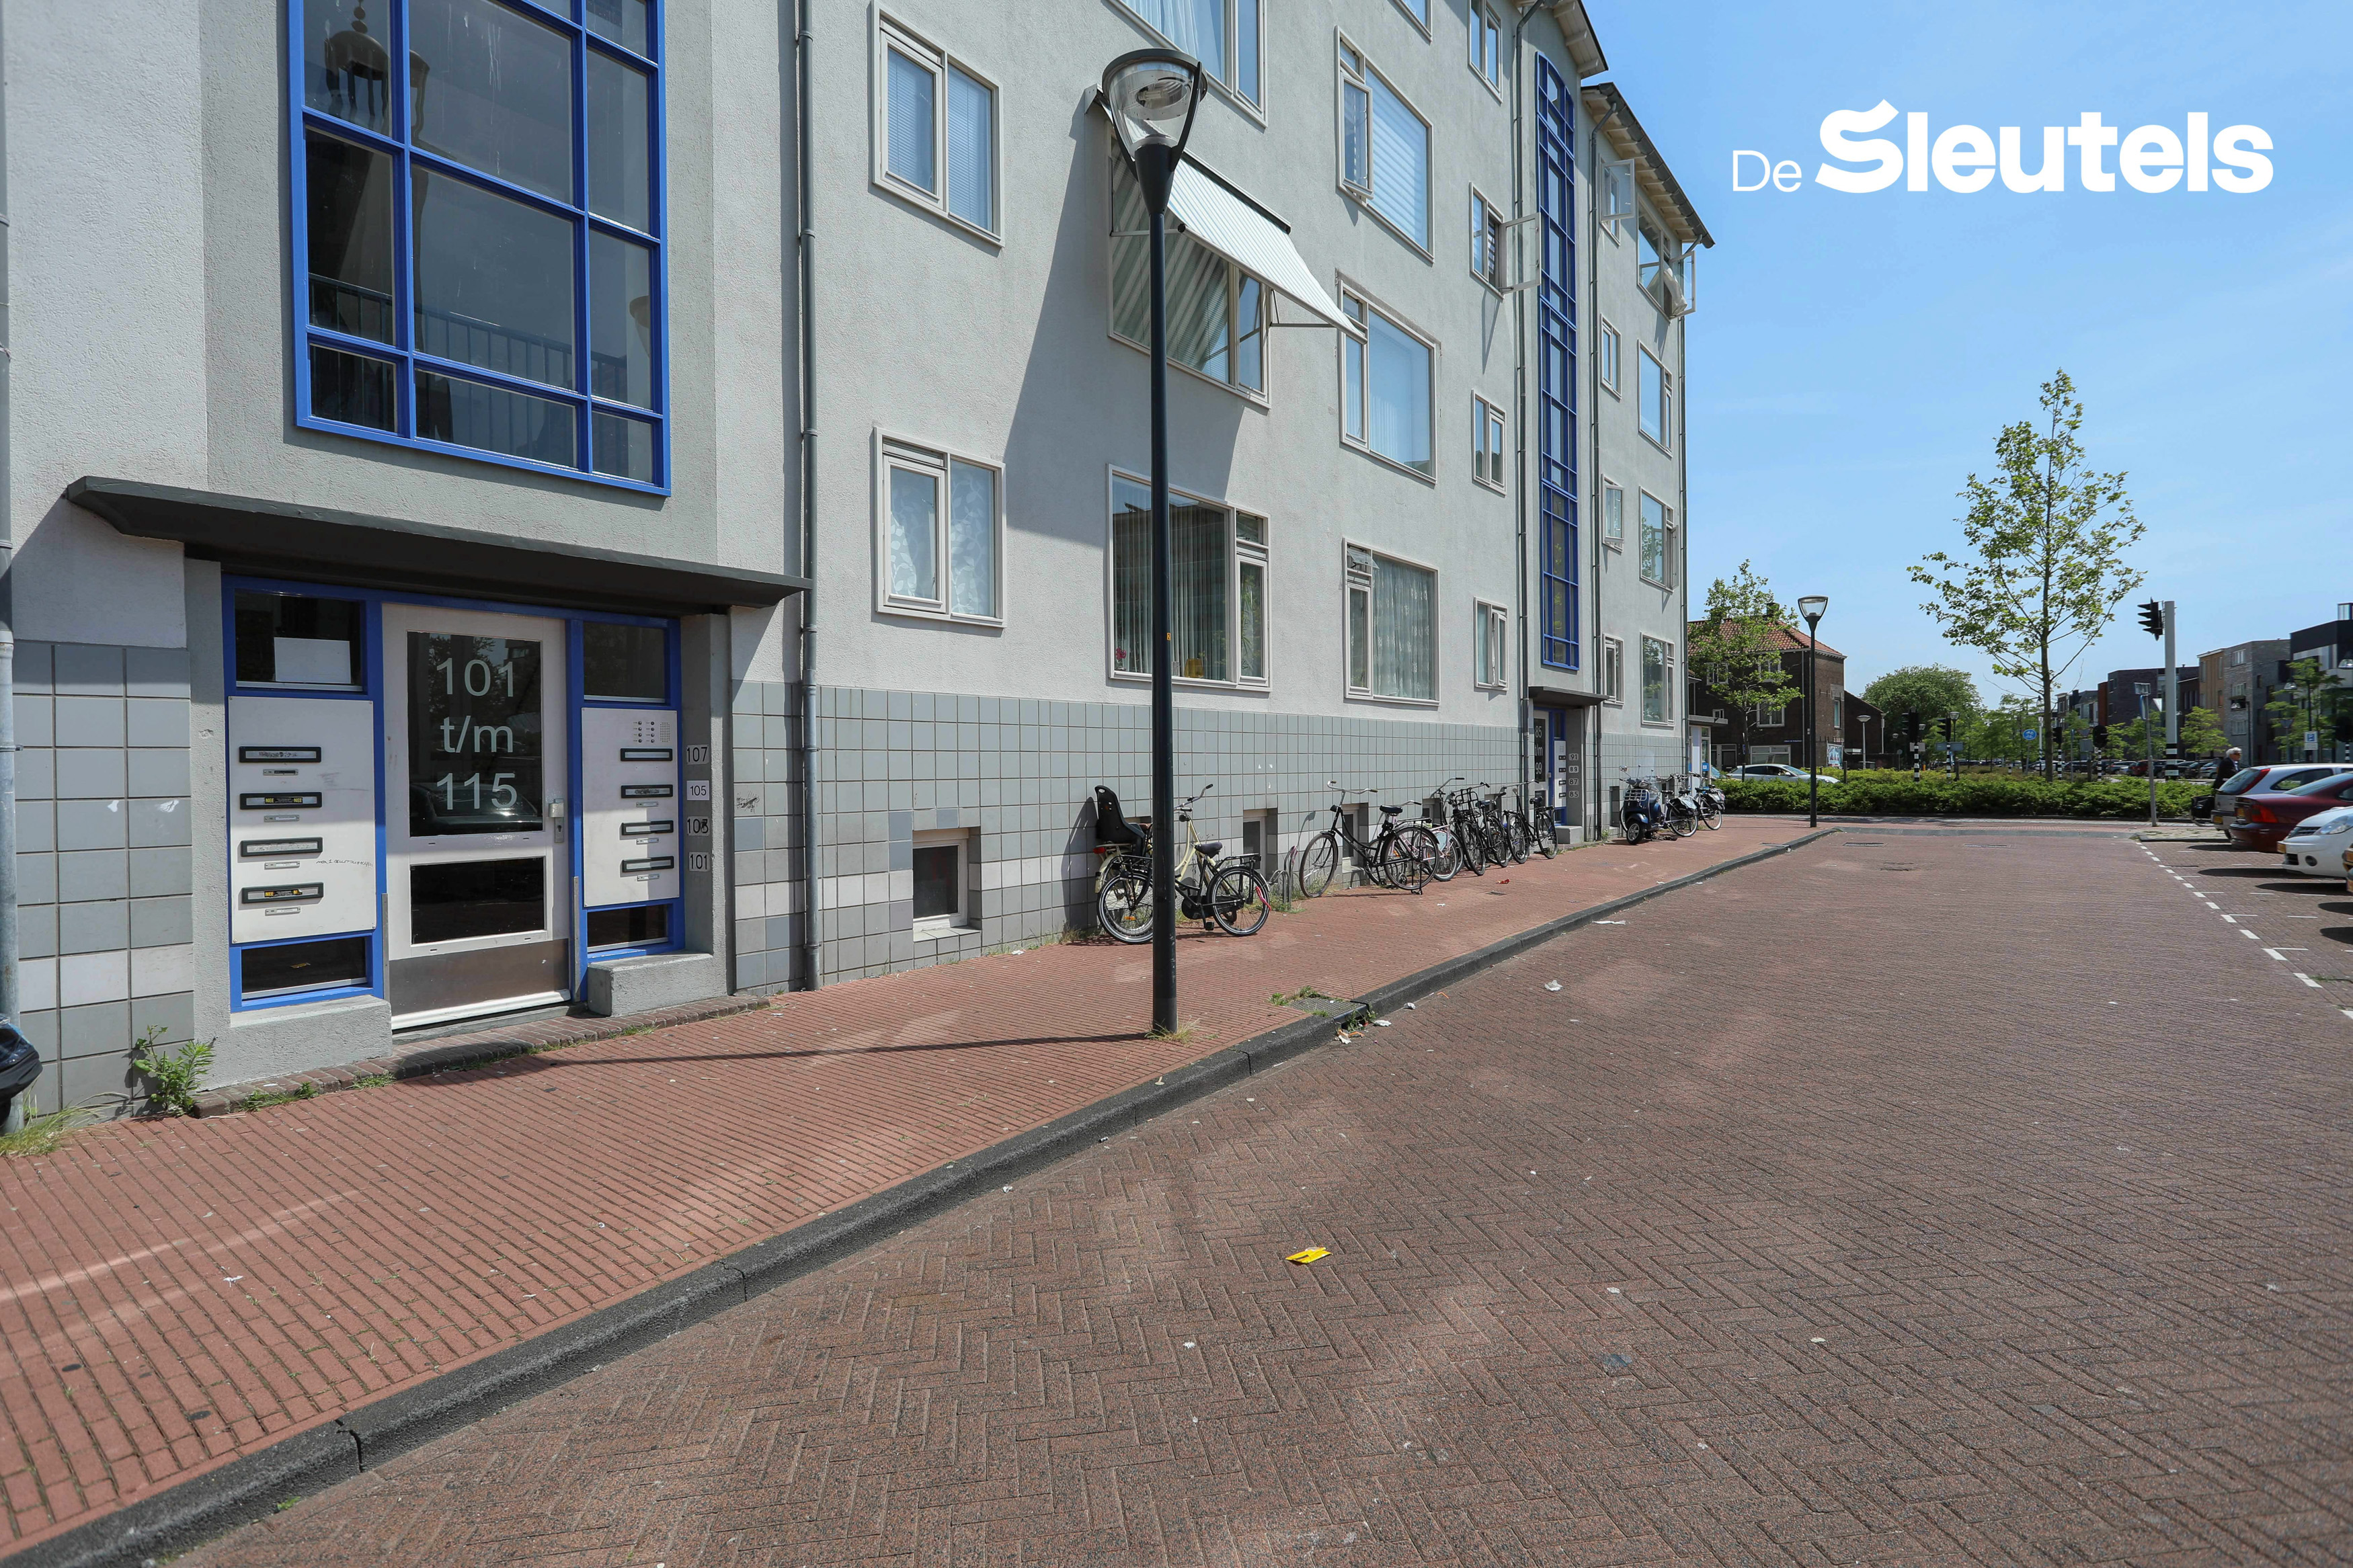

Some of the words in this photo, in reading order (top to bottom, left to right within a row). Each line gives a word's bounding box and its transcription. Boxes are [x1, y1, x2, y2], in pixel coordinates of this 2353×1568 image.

[437, 657, 514, 697] 101
[440, 715, 514, 753] t/m
[1535, 726, 1542, 738] 85
[686, 746, 708, 762] 107
[1535, 762, 1542, 774] 99
[437, 772, 518, 811] 115
[690, 785, 707, 796] 105
[687, 818, 709, 834] 103
[690, 854, 707, 870] 101
